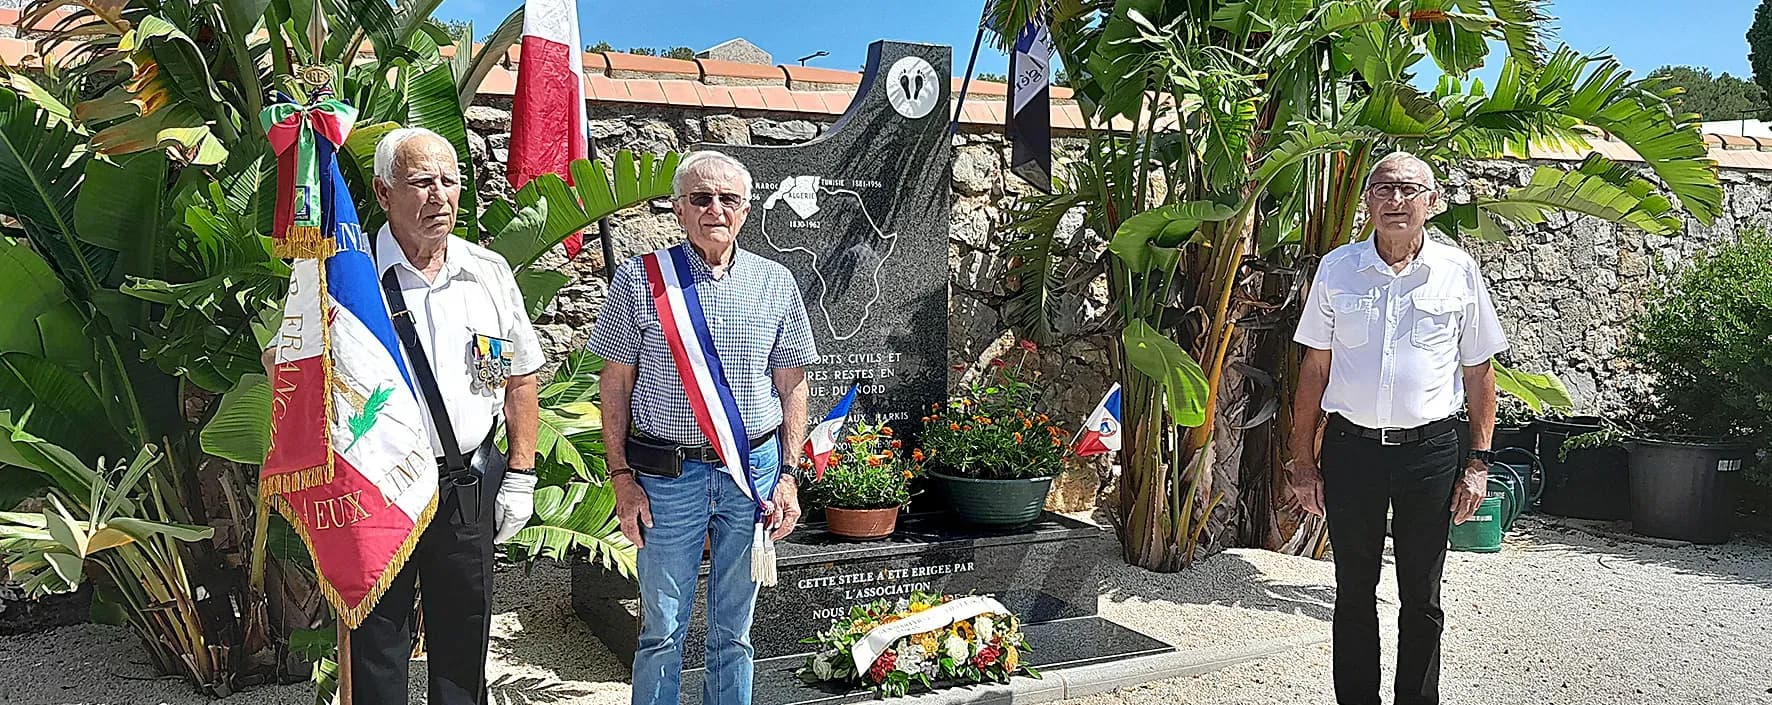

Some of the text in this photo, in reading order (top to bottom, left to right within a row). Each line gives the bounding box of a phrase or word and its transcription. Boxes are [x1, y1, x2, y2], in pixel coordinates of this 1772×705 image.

[821, 179, 845, 187] TUNISIE
[789, 220, 820, 229] 1830-1962
[848, 353, 882, 364] CIVILS
[888, 352, 902, 362] ET
[834, 369, 874, 380] RESTES
[880, 367, 895, 378] EN
[832, 385, 848, 396] DU
[855, 384, 886, 395] NORD
[847, 413, 867, 423] AUX
[313, 490, 373, 530] EUX
[798, 562, 975, 589] CETTE STELE A ETE ERIGEE PAR
[812, 606, 845, 620] NOUS
